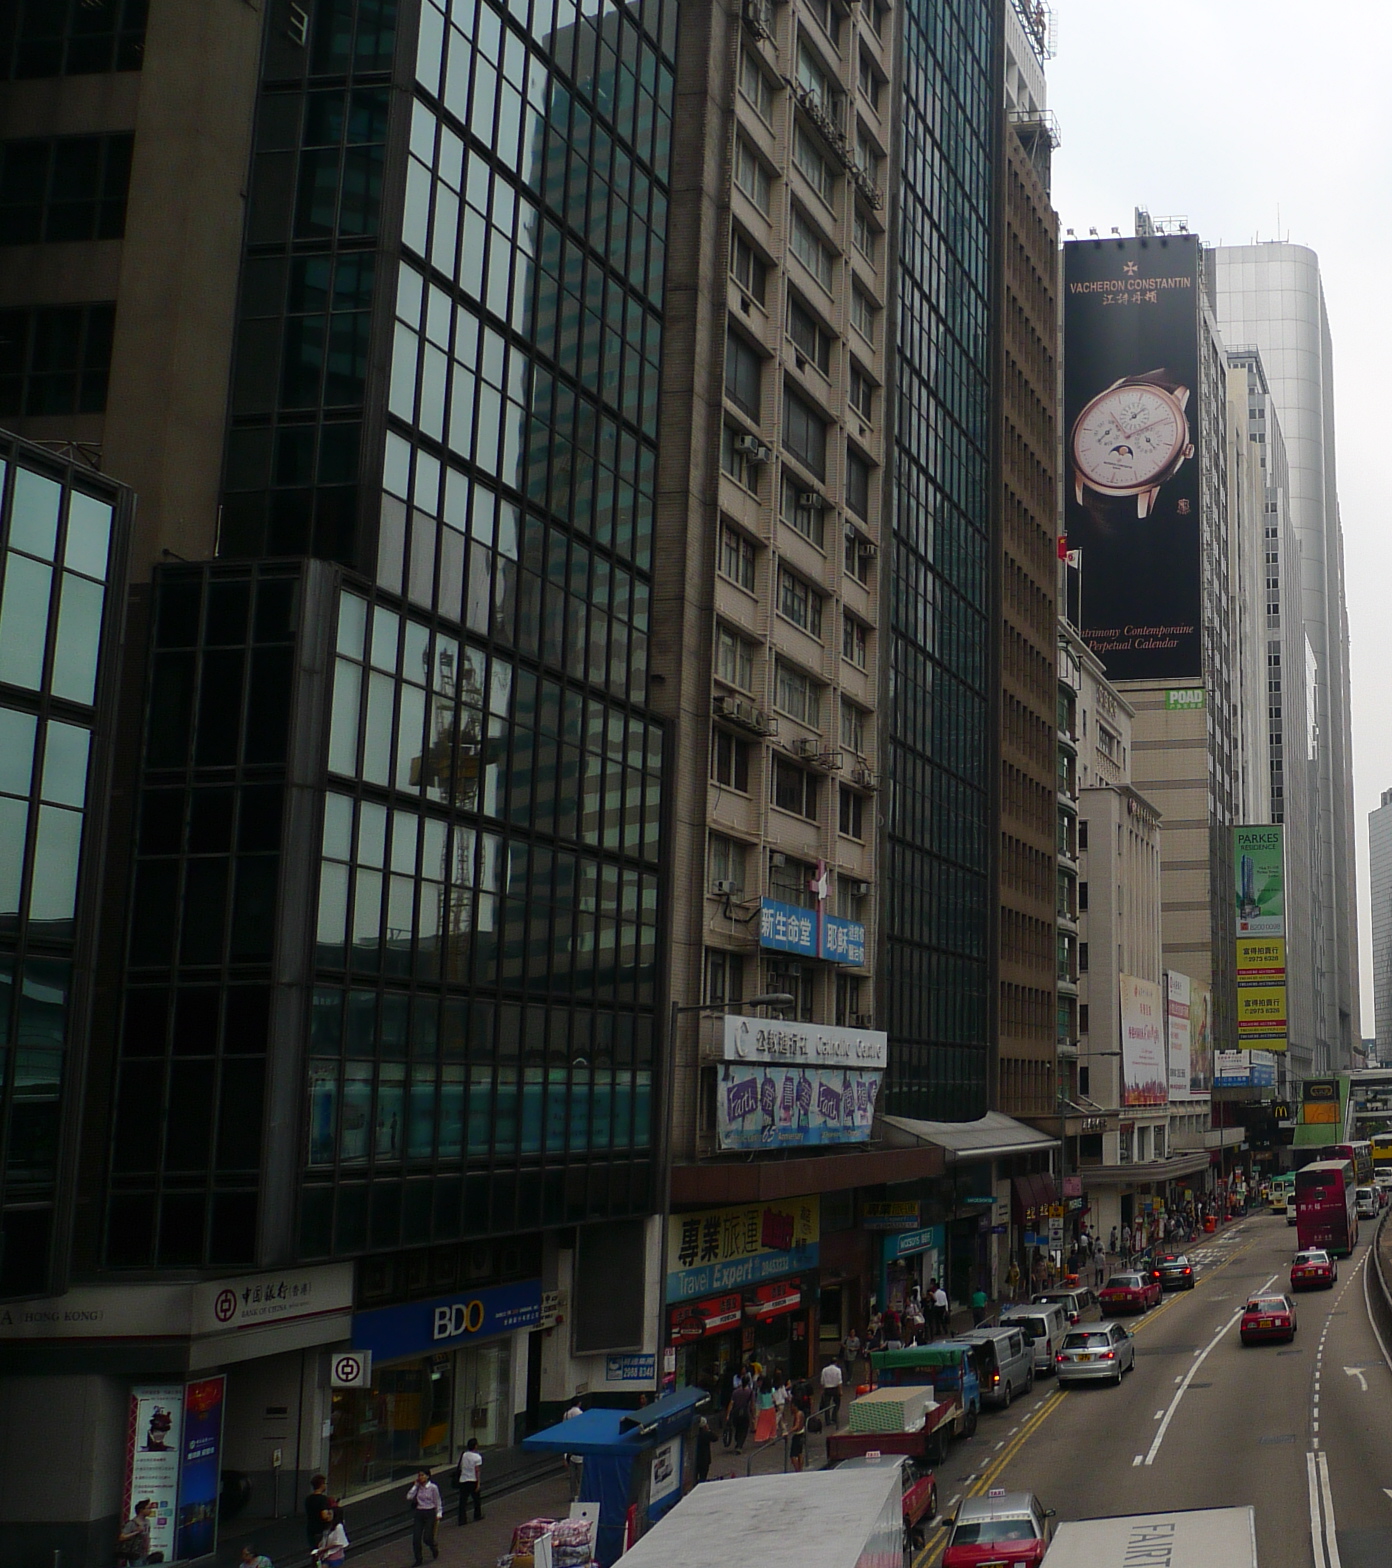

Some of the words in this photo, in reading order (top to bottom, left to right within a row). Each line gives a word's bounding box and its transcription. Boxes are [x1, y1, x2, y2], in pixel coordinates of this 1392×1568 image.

[1070, 281, 1125, 294] VACHERON
[1127, 277, 1191, 291] CONSTANTIN
[1124, 623, 1194, 637] Contemporaine
[1088, 639, 1131, 654] Perpetual
[1134, 637, 1179, 650] Calendar
[1169, 690, 1203, 704] POAD
[1238, 833, 1279, 844] PARKES
[761, 907, 811, 946] 新生命堂
[816, 1034, 850, 1057] Catholic
[856, 1038, 881, 1060] Centre
[729, 1086, 755, 1122] Faith
[679, 1210, 759, 1267] 專業旅運
[678, 1268, 709, 1295] Travel
[713, 1258, 752, 1289] Expert
[434, 1300, 484, 1340] BDO
